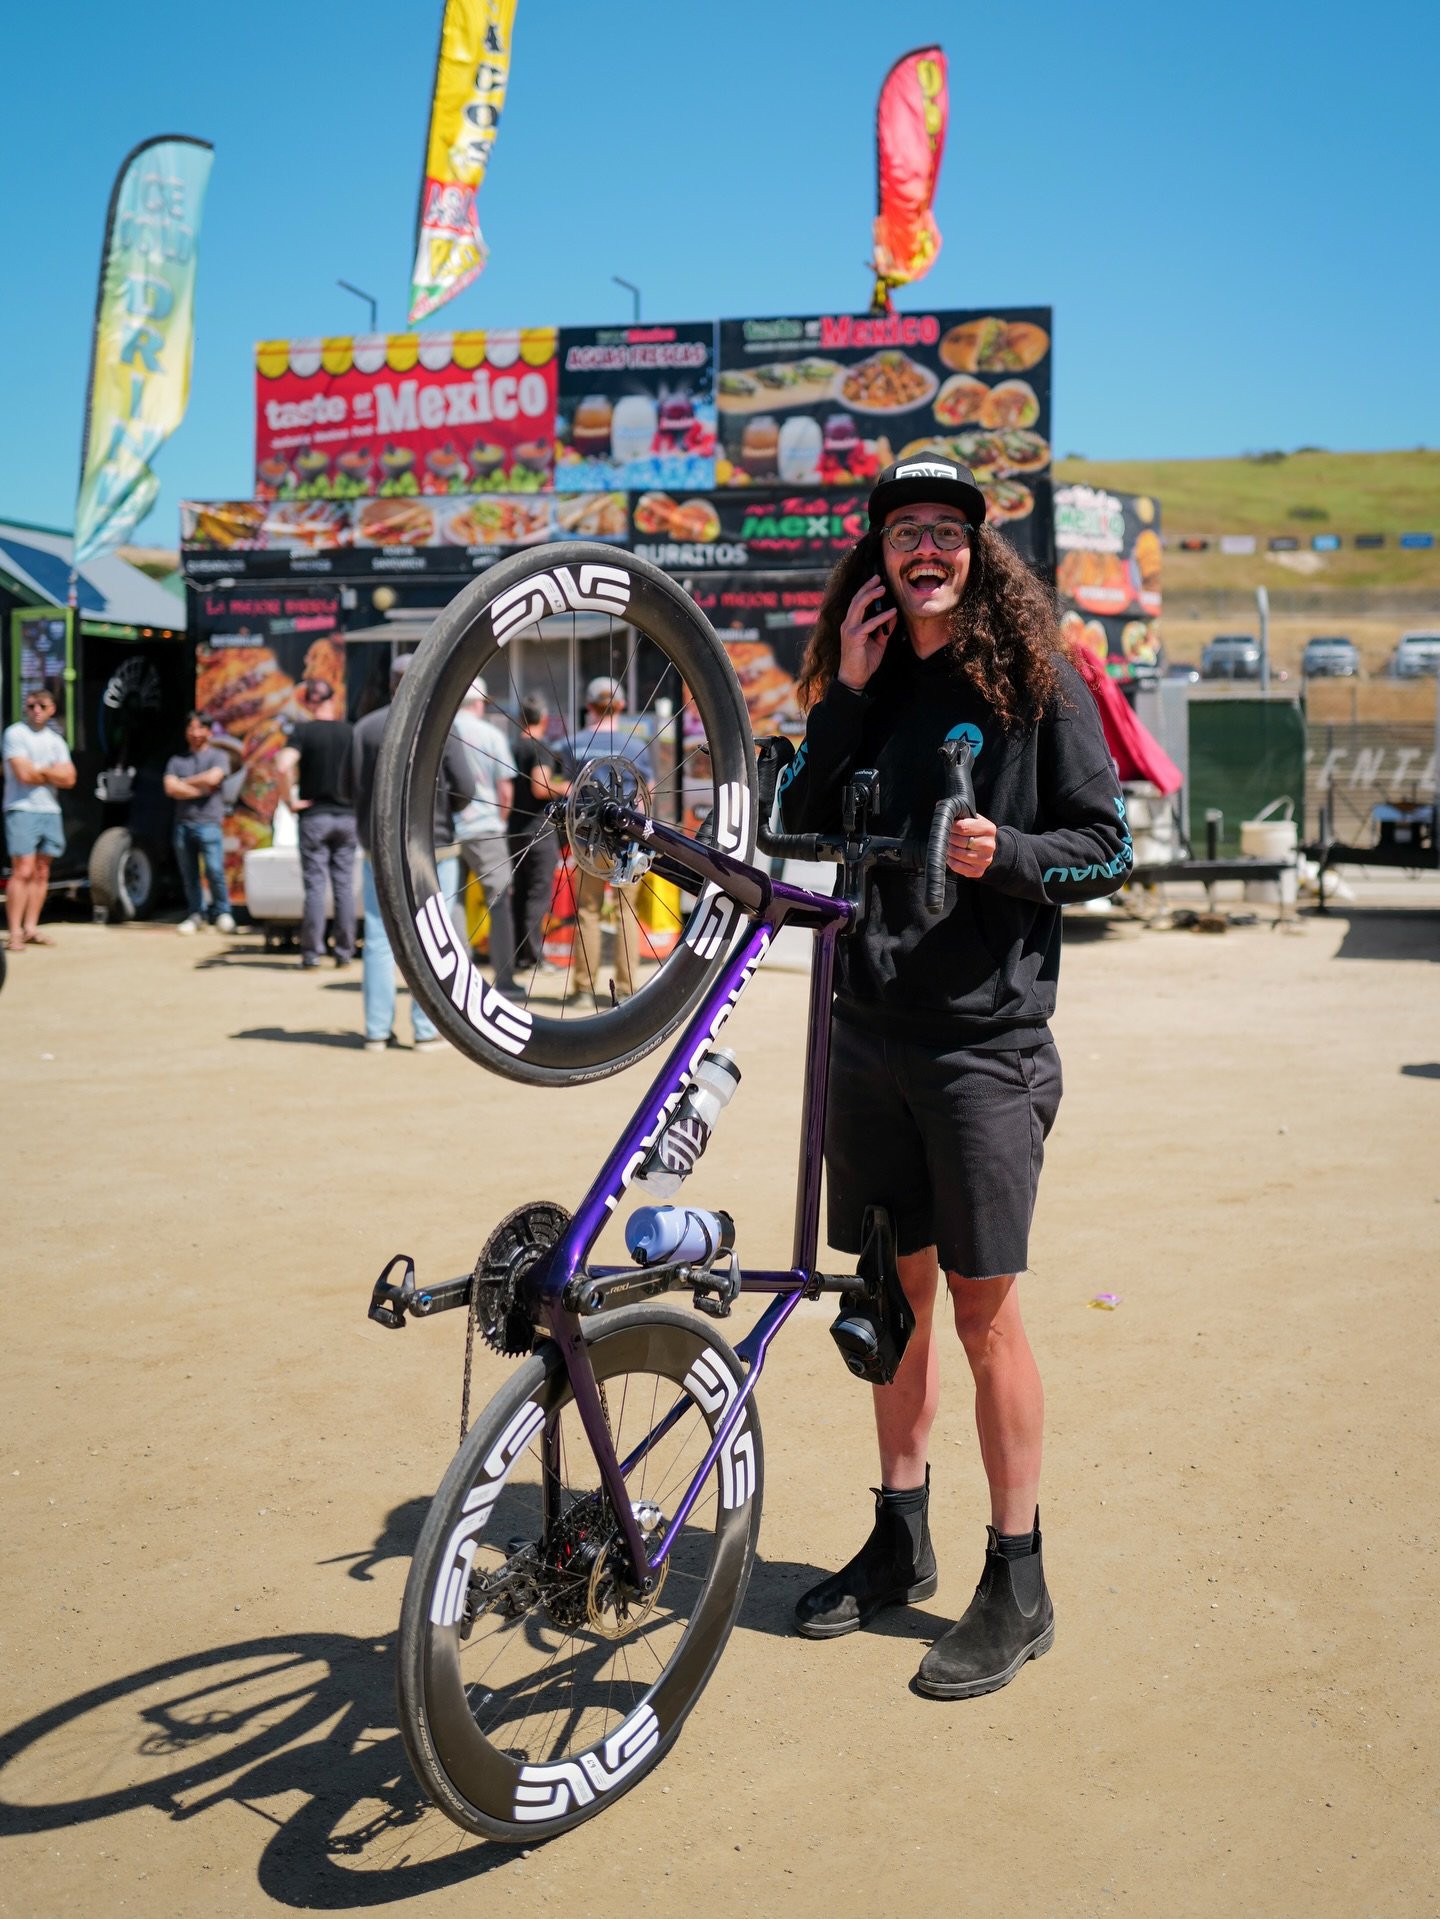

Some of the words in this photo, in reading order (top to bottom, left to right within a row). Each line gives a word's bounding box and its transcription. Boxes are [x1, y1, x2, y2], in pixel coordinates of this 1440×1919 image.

[819, 311, 940, 348] Mexico
[264, 393, 347, 431] taste
[374, 368, 548, 434] Mexico
[634, 543, 748, 566] BURRITOS
[420, 1727, 434, 1759] 5000
[428, 1759, 444, 1784] PRIX
[440, 1782, 464, 1811] GRAND
